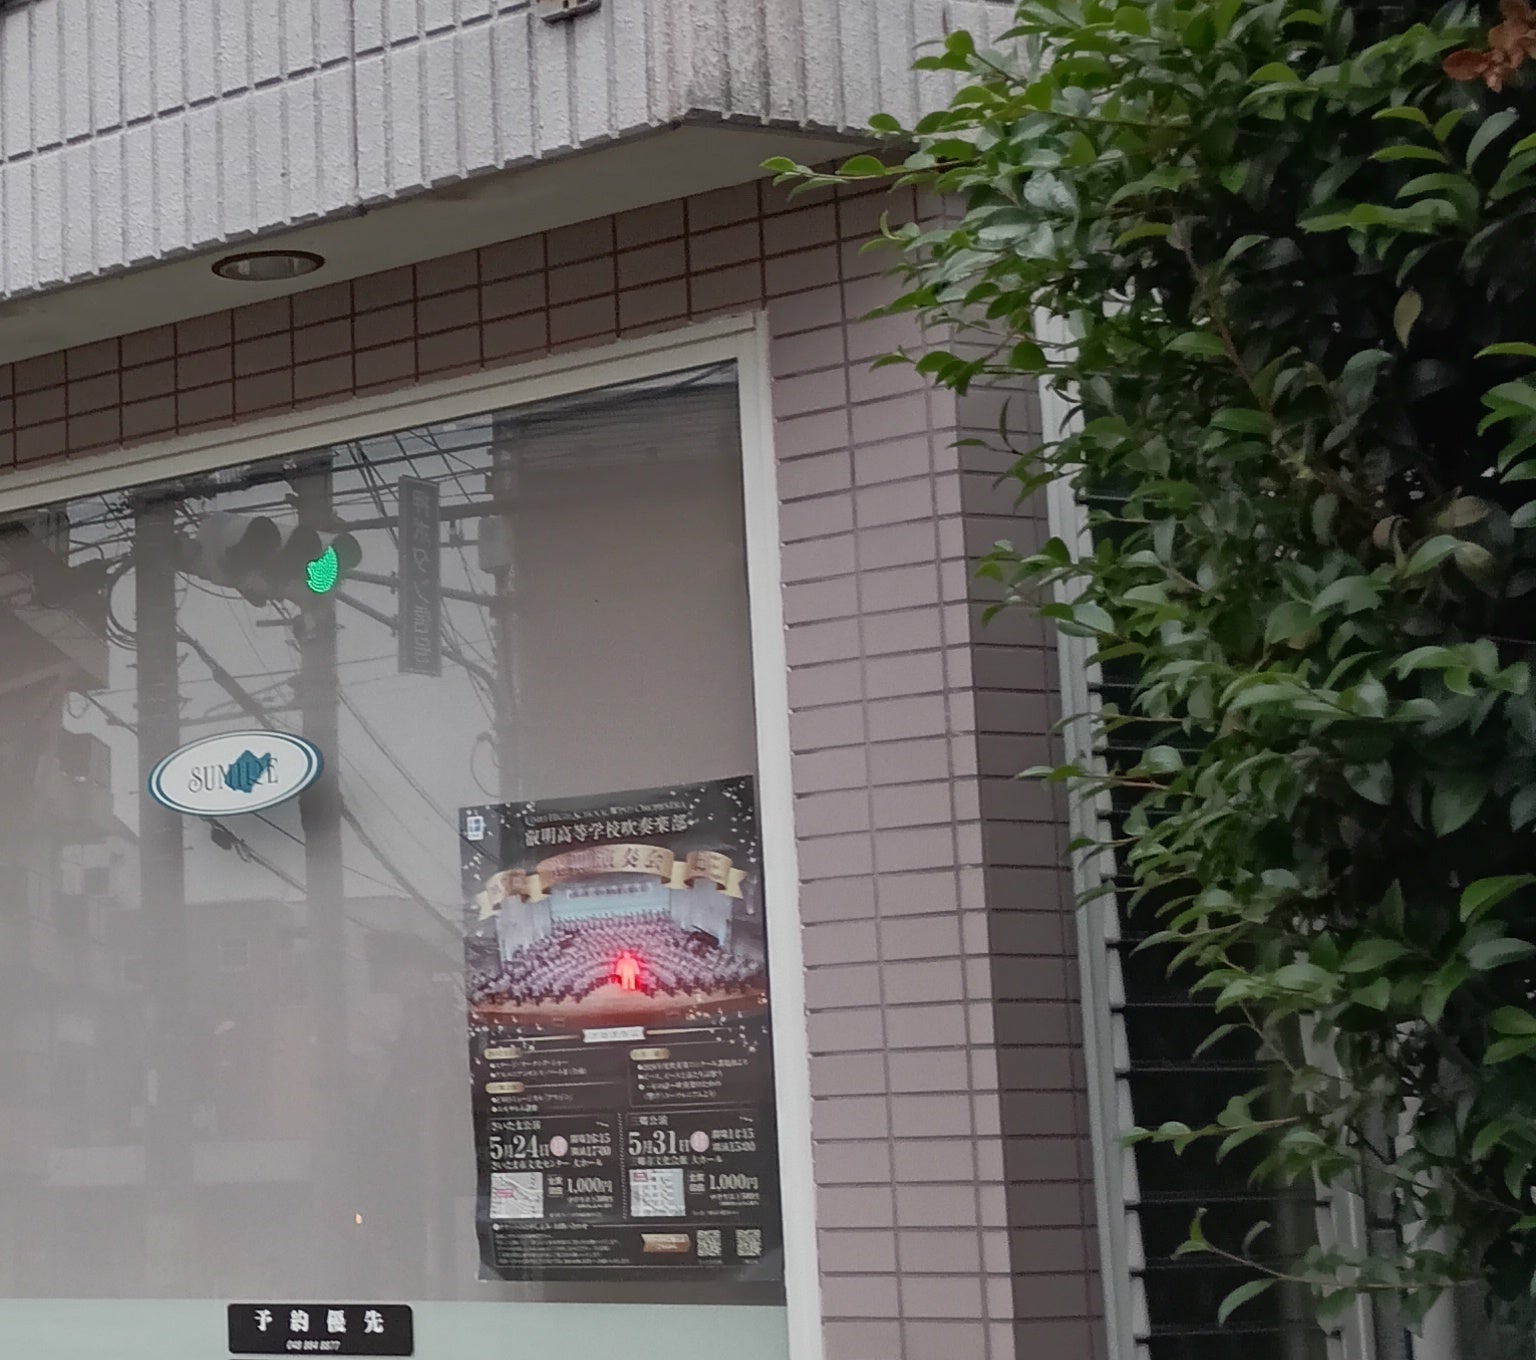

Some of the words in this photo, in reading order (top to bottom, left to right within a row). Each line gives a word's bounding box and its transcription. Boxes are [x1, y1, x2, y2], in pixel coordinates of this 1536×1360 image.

[187, 755, 279, 793] SUMIRE
[253, 1308, 385, 1334] 予約優先
